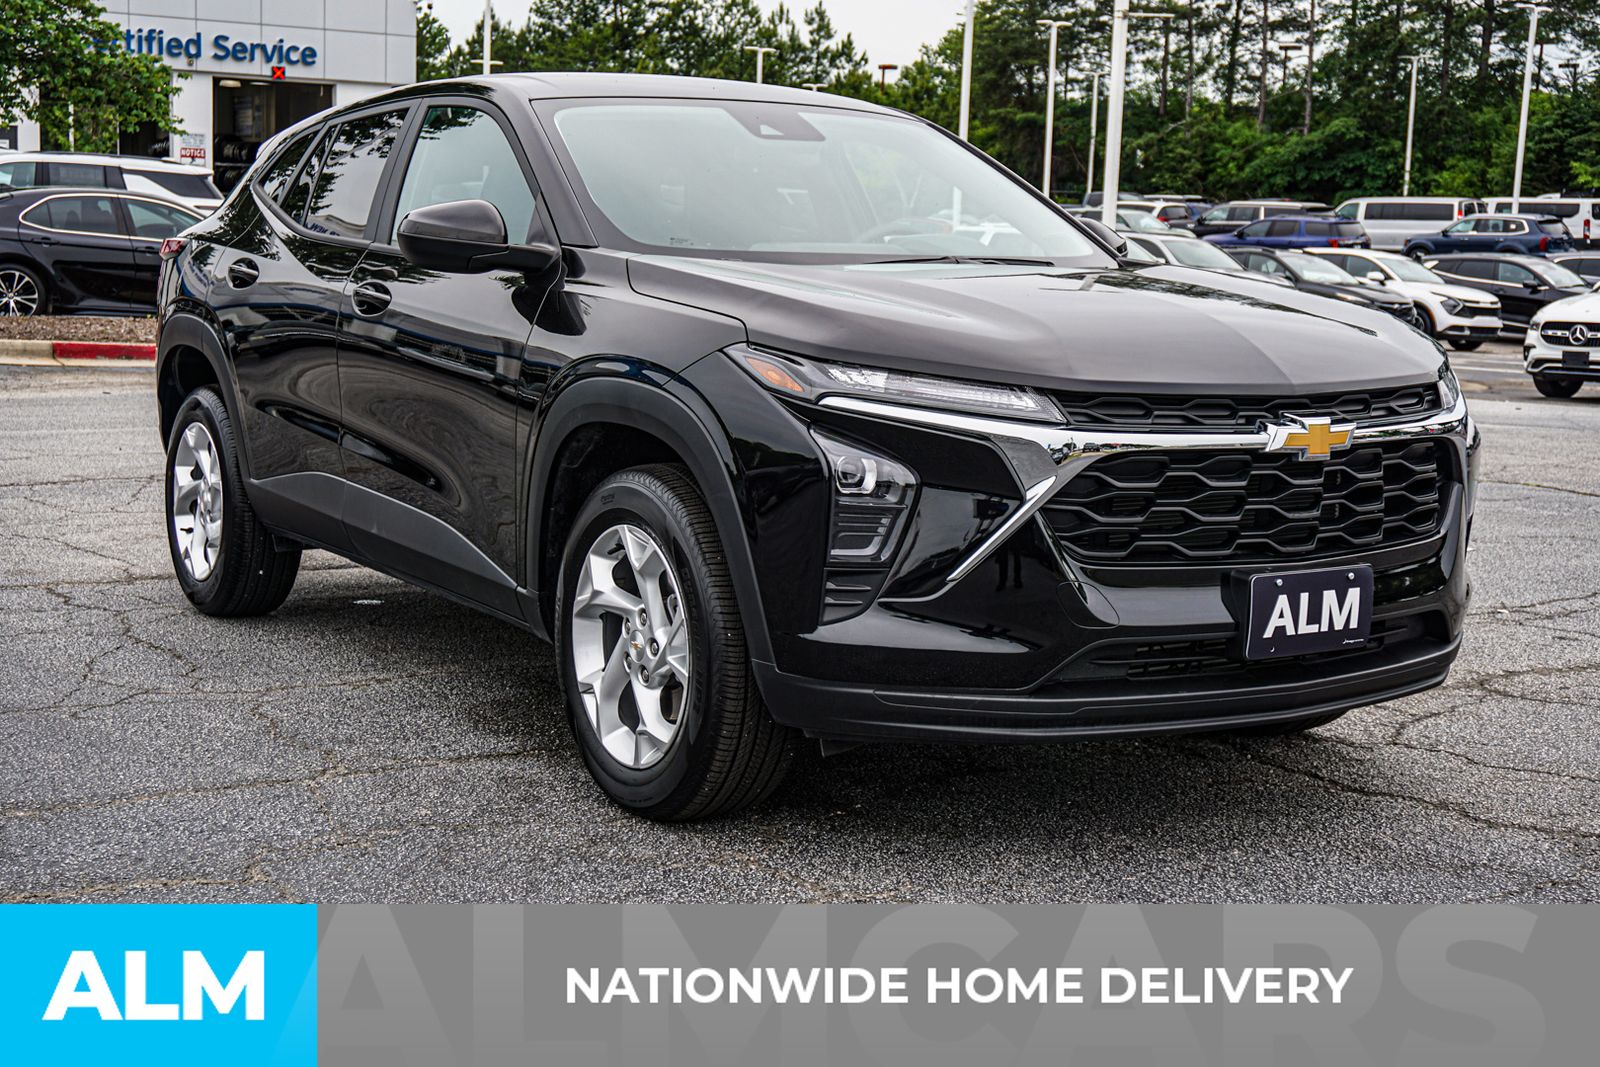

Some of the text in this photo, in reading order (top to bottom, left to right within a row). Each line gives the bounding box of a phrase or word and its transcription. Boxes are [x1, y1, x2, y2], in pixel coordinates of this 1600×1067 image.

[212, 34, 318, 66] Service
[181, 149, 206, 157] NOTICE
[1262, 587, 1361, 639] ALM
